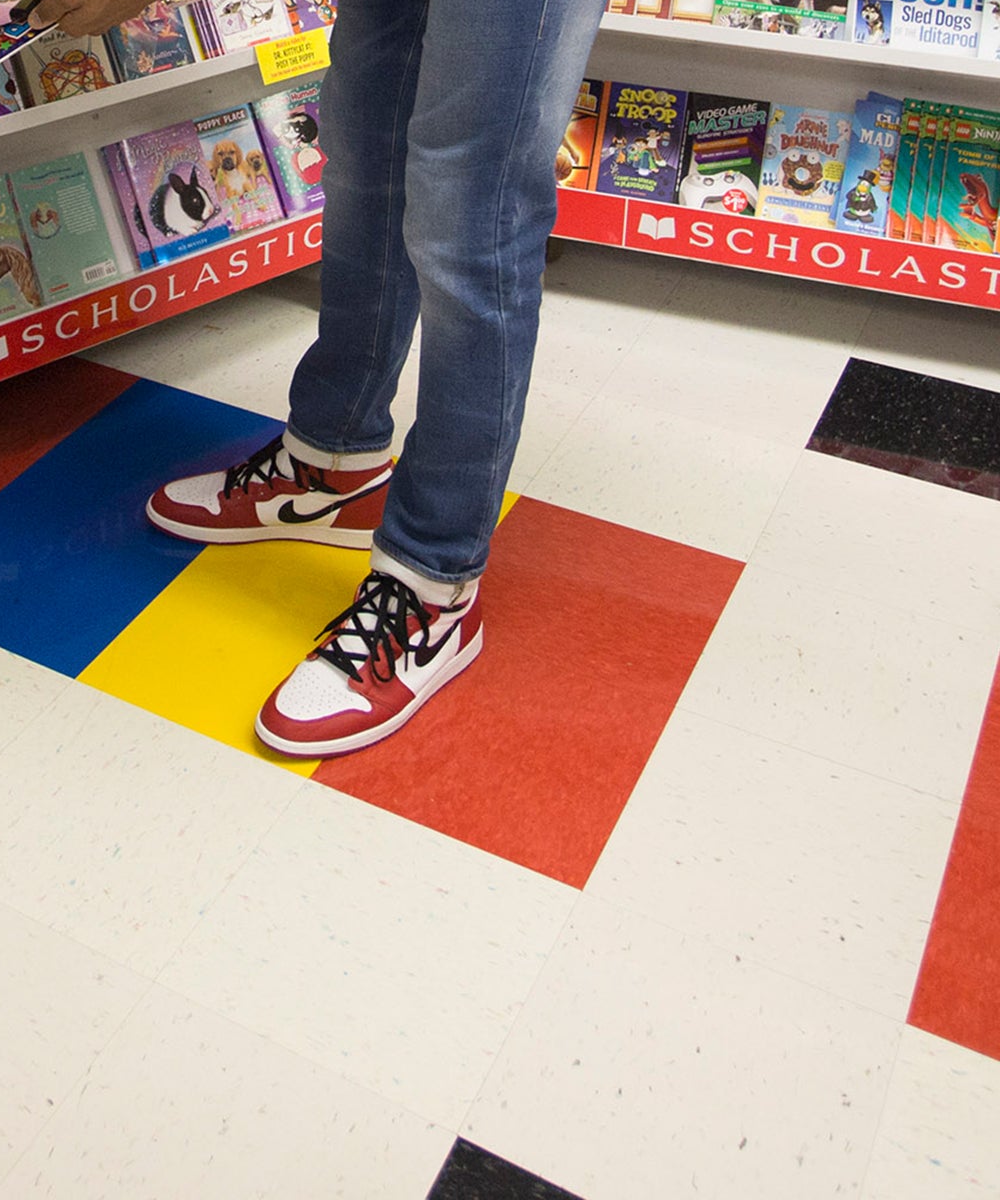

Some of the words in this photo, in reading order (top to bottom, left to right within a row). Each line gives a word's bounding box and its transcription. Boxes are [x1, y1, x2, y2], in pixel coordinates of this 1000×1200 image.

[722, 0, 739, 8] Open
[901, 5, 933, 26] Sled
[935, 9, 973, 32] Dogs
[918, 25, 979, 49] Iditarod
[618, 87, 678, 108] SNOOP
[196, 118, 222, 133] PUPPY
[222, 108, 247, 125] PLACE
[615, 102, 679, 125] TROOP
[687, 110, 767, 136] MASTER
[696, 107, 727, 120] VIDEO
[728, 103, 758, 117] GAME
[858, 127, 895, 149] MAD
[956, 127, 971, 136] LEGO
[780, 133, 840, 159] DOUGHNUT
[957, 149, 981, 159] TOMB
[983, 153, 996, 161] OF
[687, 220, 1000, 295] SCHOLAST
[21, 221, 323, 355] SCHOLASTIC
